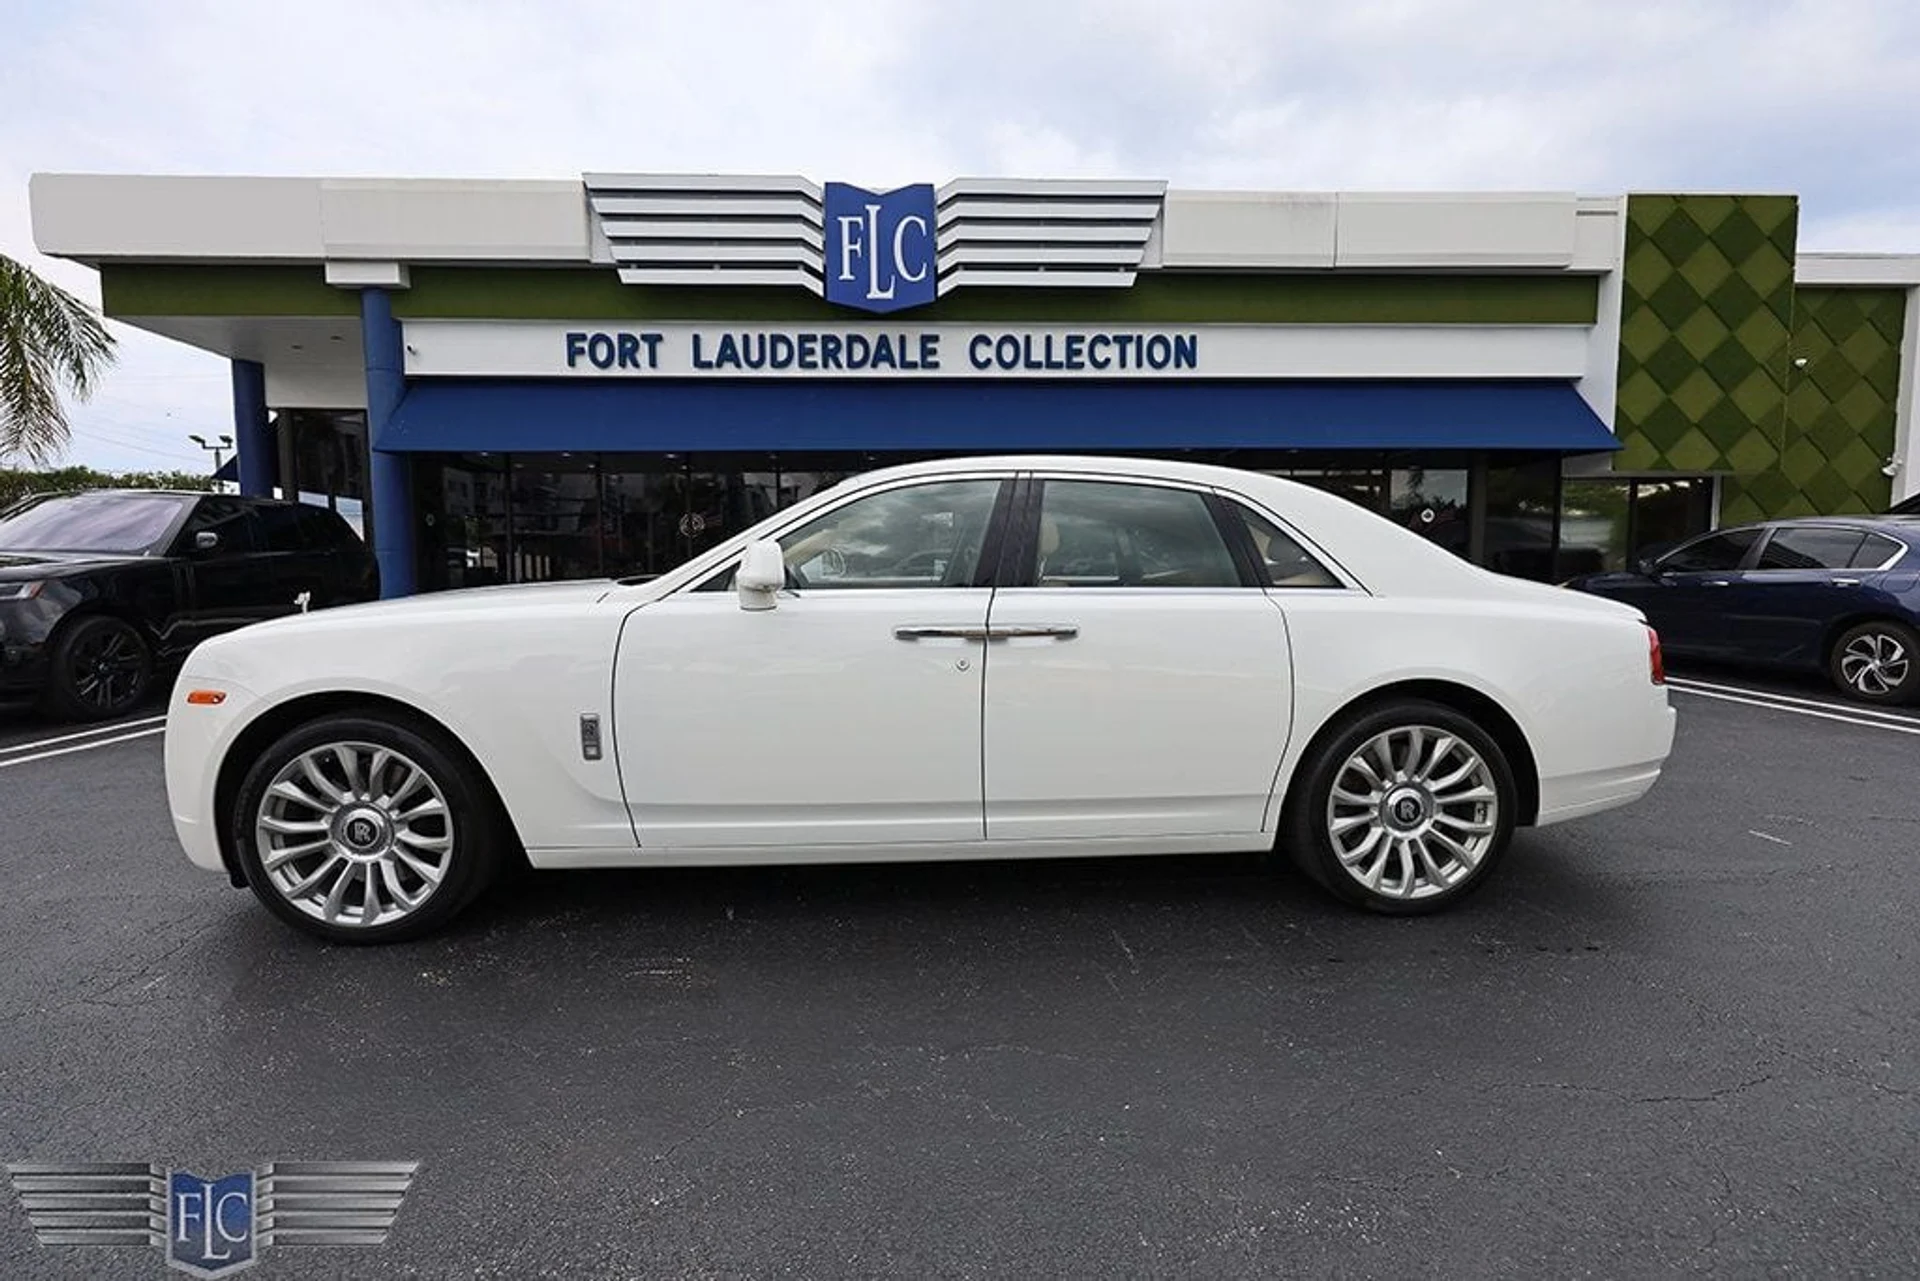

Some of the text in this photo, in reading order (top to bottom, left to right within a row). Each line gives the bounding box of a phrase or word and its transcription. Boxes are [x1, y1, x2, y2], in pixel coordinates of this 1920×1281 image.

[838, 204, 928, 300] FLC
[566, 333, 1198, 370] FORT LAUDERDALE COLLECTION
